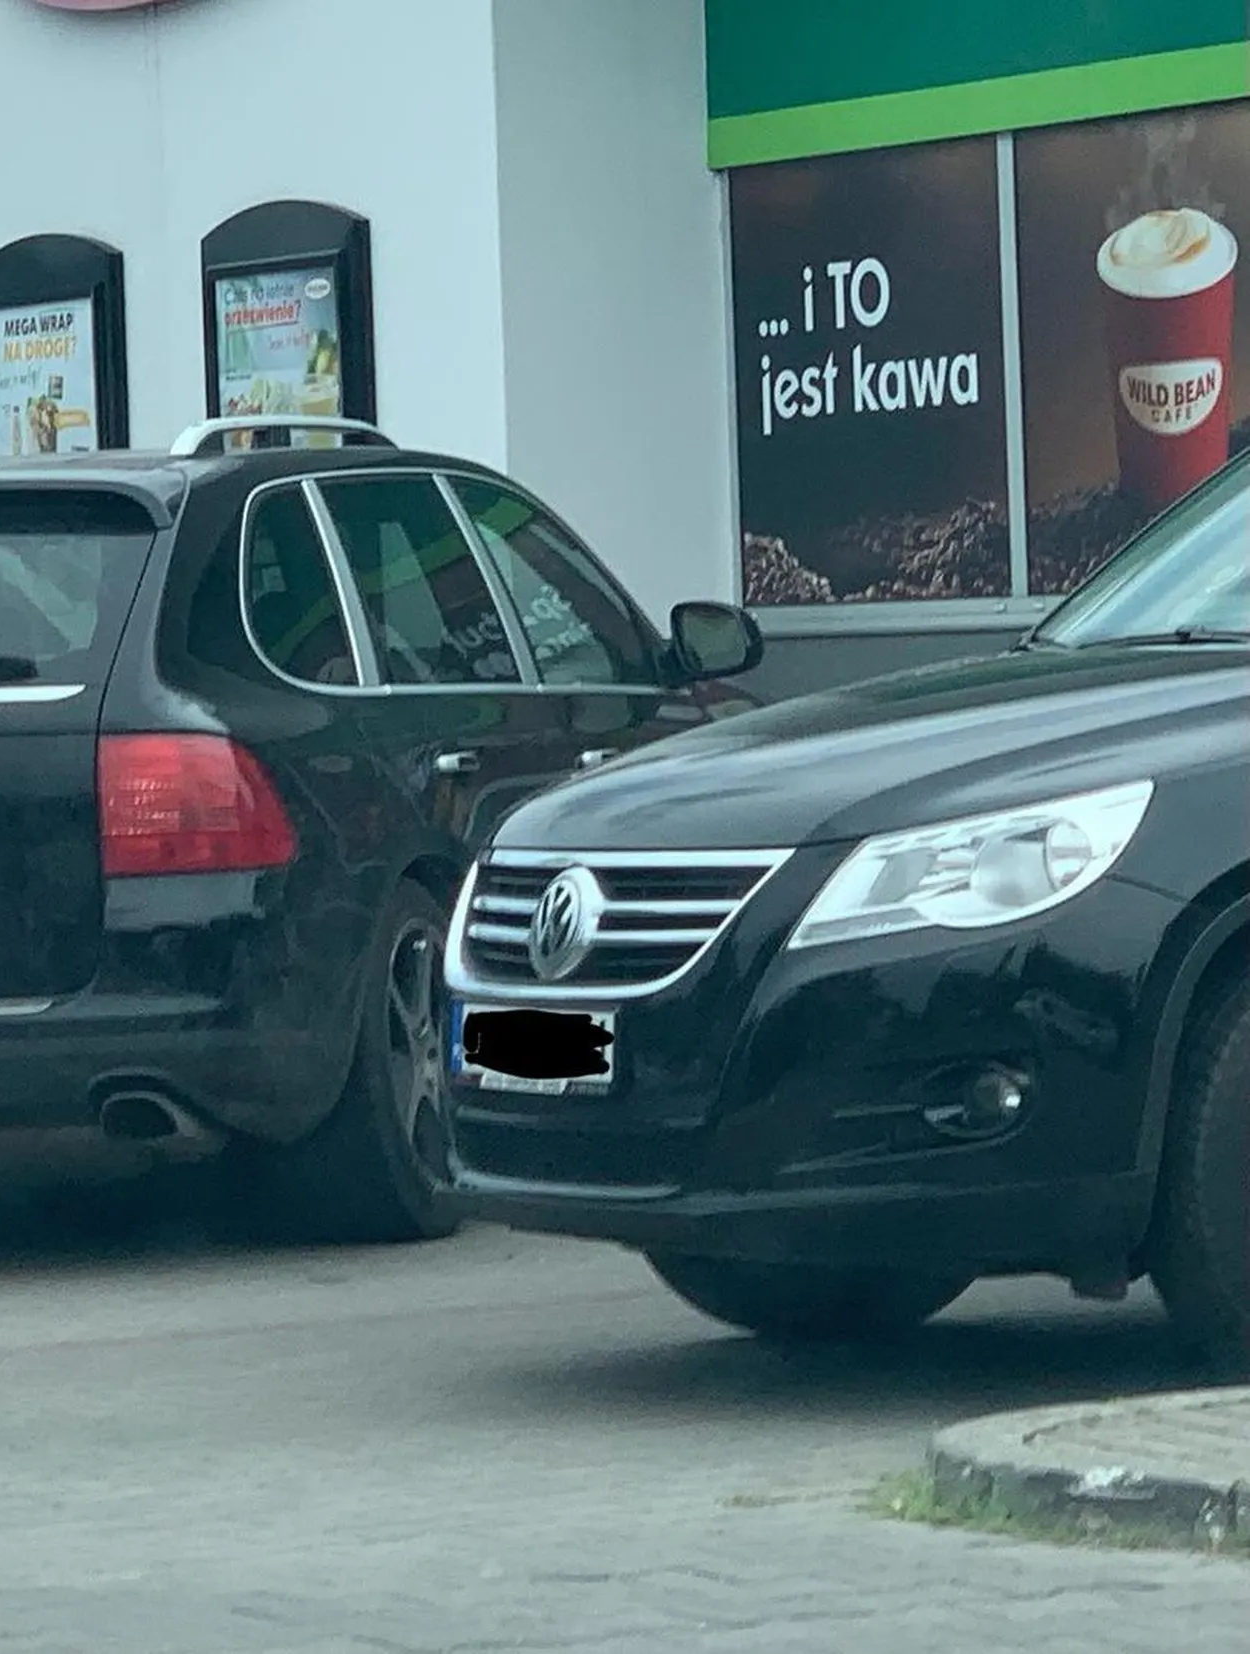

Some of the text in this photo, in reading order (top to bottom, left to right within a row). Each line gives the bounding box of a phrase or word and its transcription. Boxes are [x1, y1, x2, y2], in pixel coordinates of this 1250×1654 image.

[803, 266, 814, 332] i
[827, 257, 891, 330] TO
[4, 313, 74, 337] MEGA WRAP
[4, 341, 22, 361] NA
[761, 343, 979, 436] jest kawa
[1126, 368, 1216, 407] WILD BEAN
